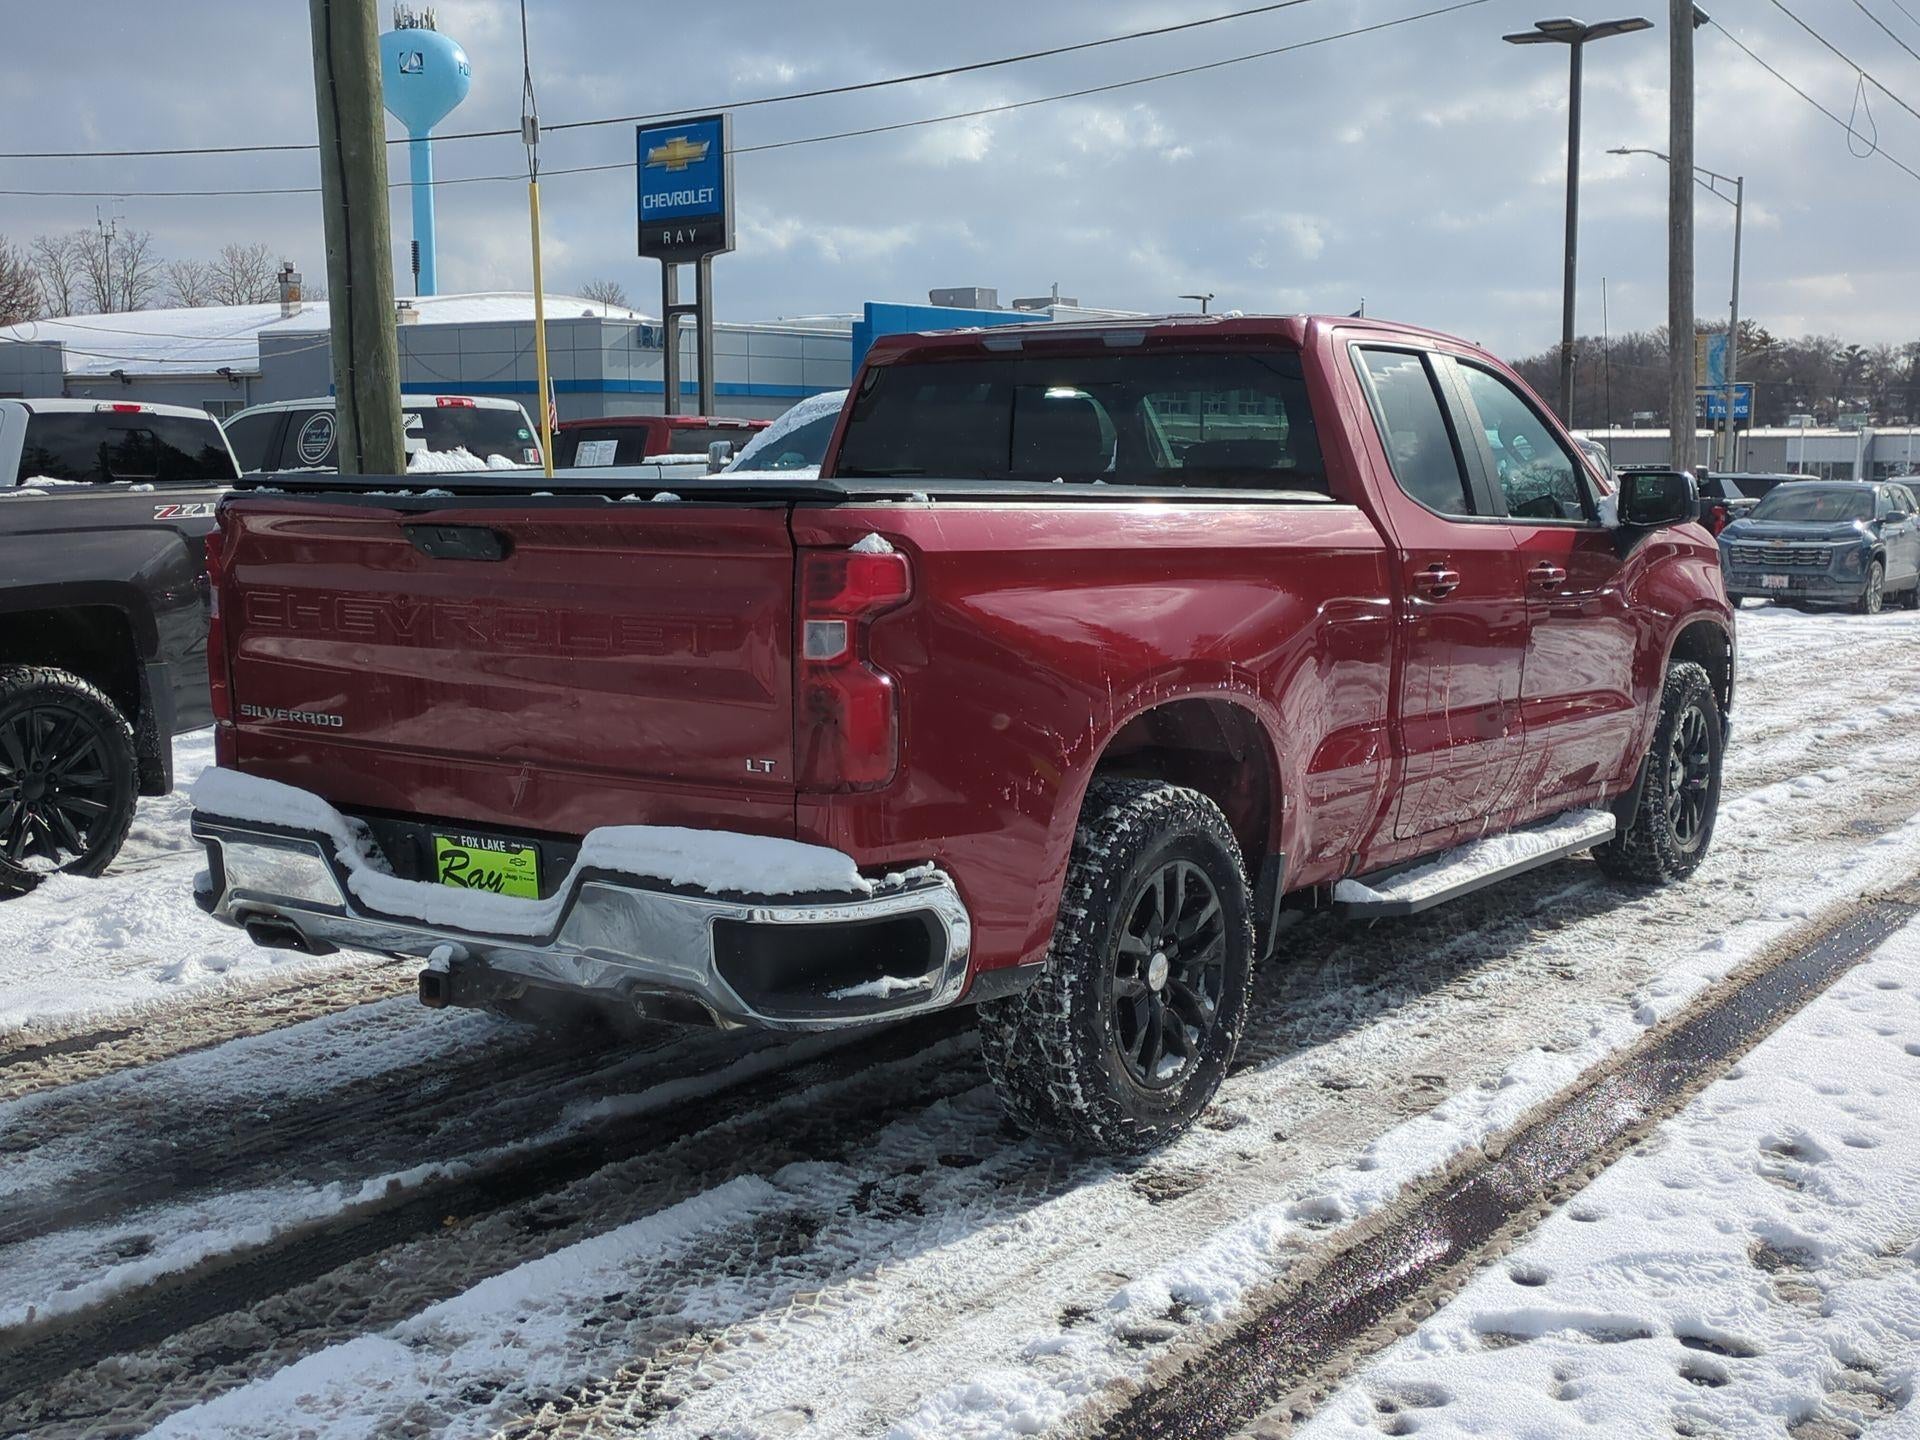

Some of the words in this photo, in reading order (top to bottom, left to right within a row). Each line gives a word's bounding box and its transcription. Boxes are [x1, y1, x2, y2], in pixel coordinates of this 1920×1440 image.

[643, 188, 714, 209] CHEVROLET
[663, 229, 697, 244] RAY
[153, 503, 216, 519] Z71
[246, 591, 735, 657] CHEVROLET
[241, 704, 343, 727] SILVERADO
[746, 759, 775, 773] LT
[461, 836, 479, 848] FOX
[481, 838, 506, 852] LAKE
[439, 849, 505, 893] Ray
